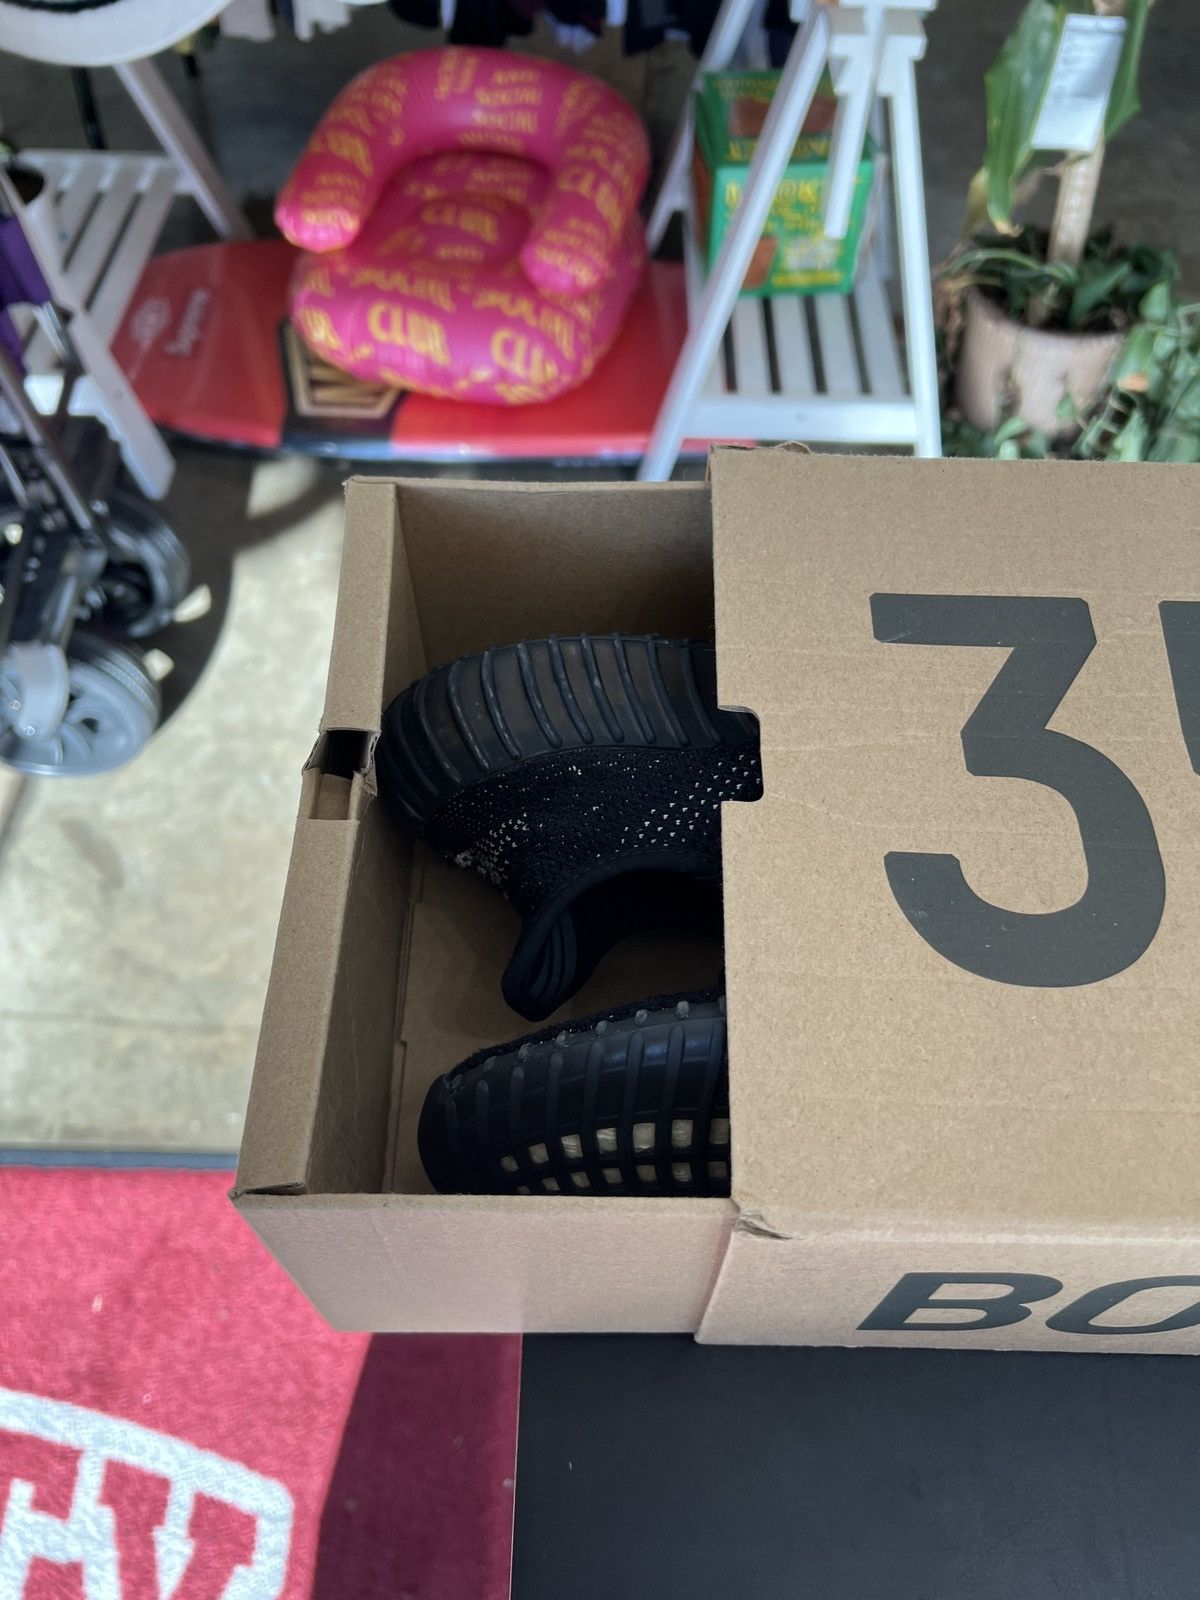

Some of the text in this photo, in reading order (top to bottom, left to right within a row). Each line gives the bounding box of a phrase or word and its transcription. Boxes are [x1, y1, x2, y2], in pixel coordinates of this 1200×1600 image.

[366, 301, 451, 366] CLUB
[869, 592, 1200, 988] 3
[855, 1271, 1200, 1336] BO
